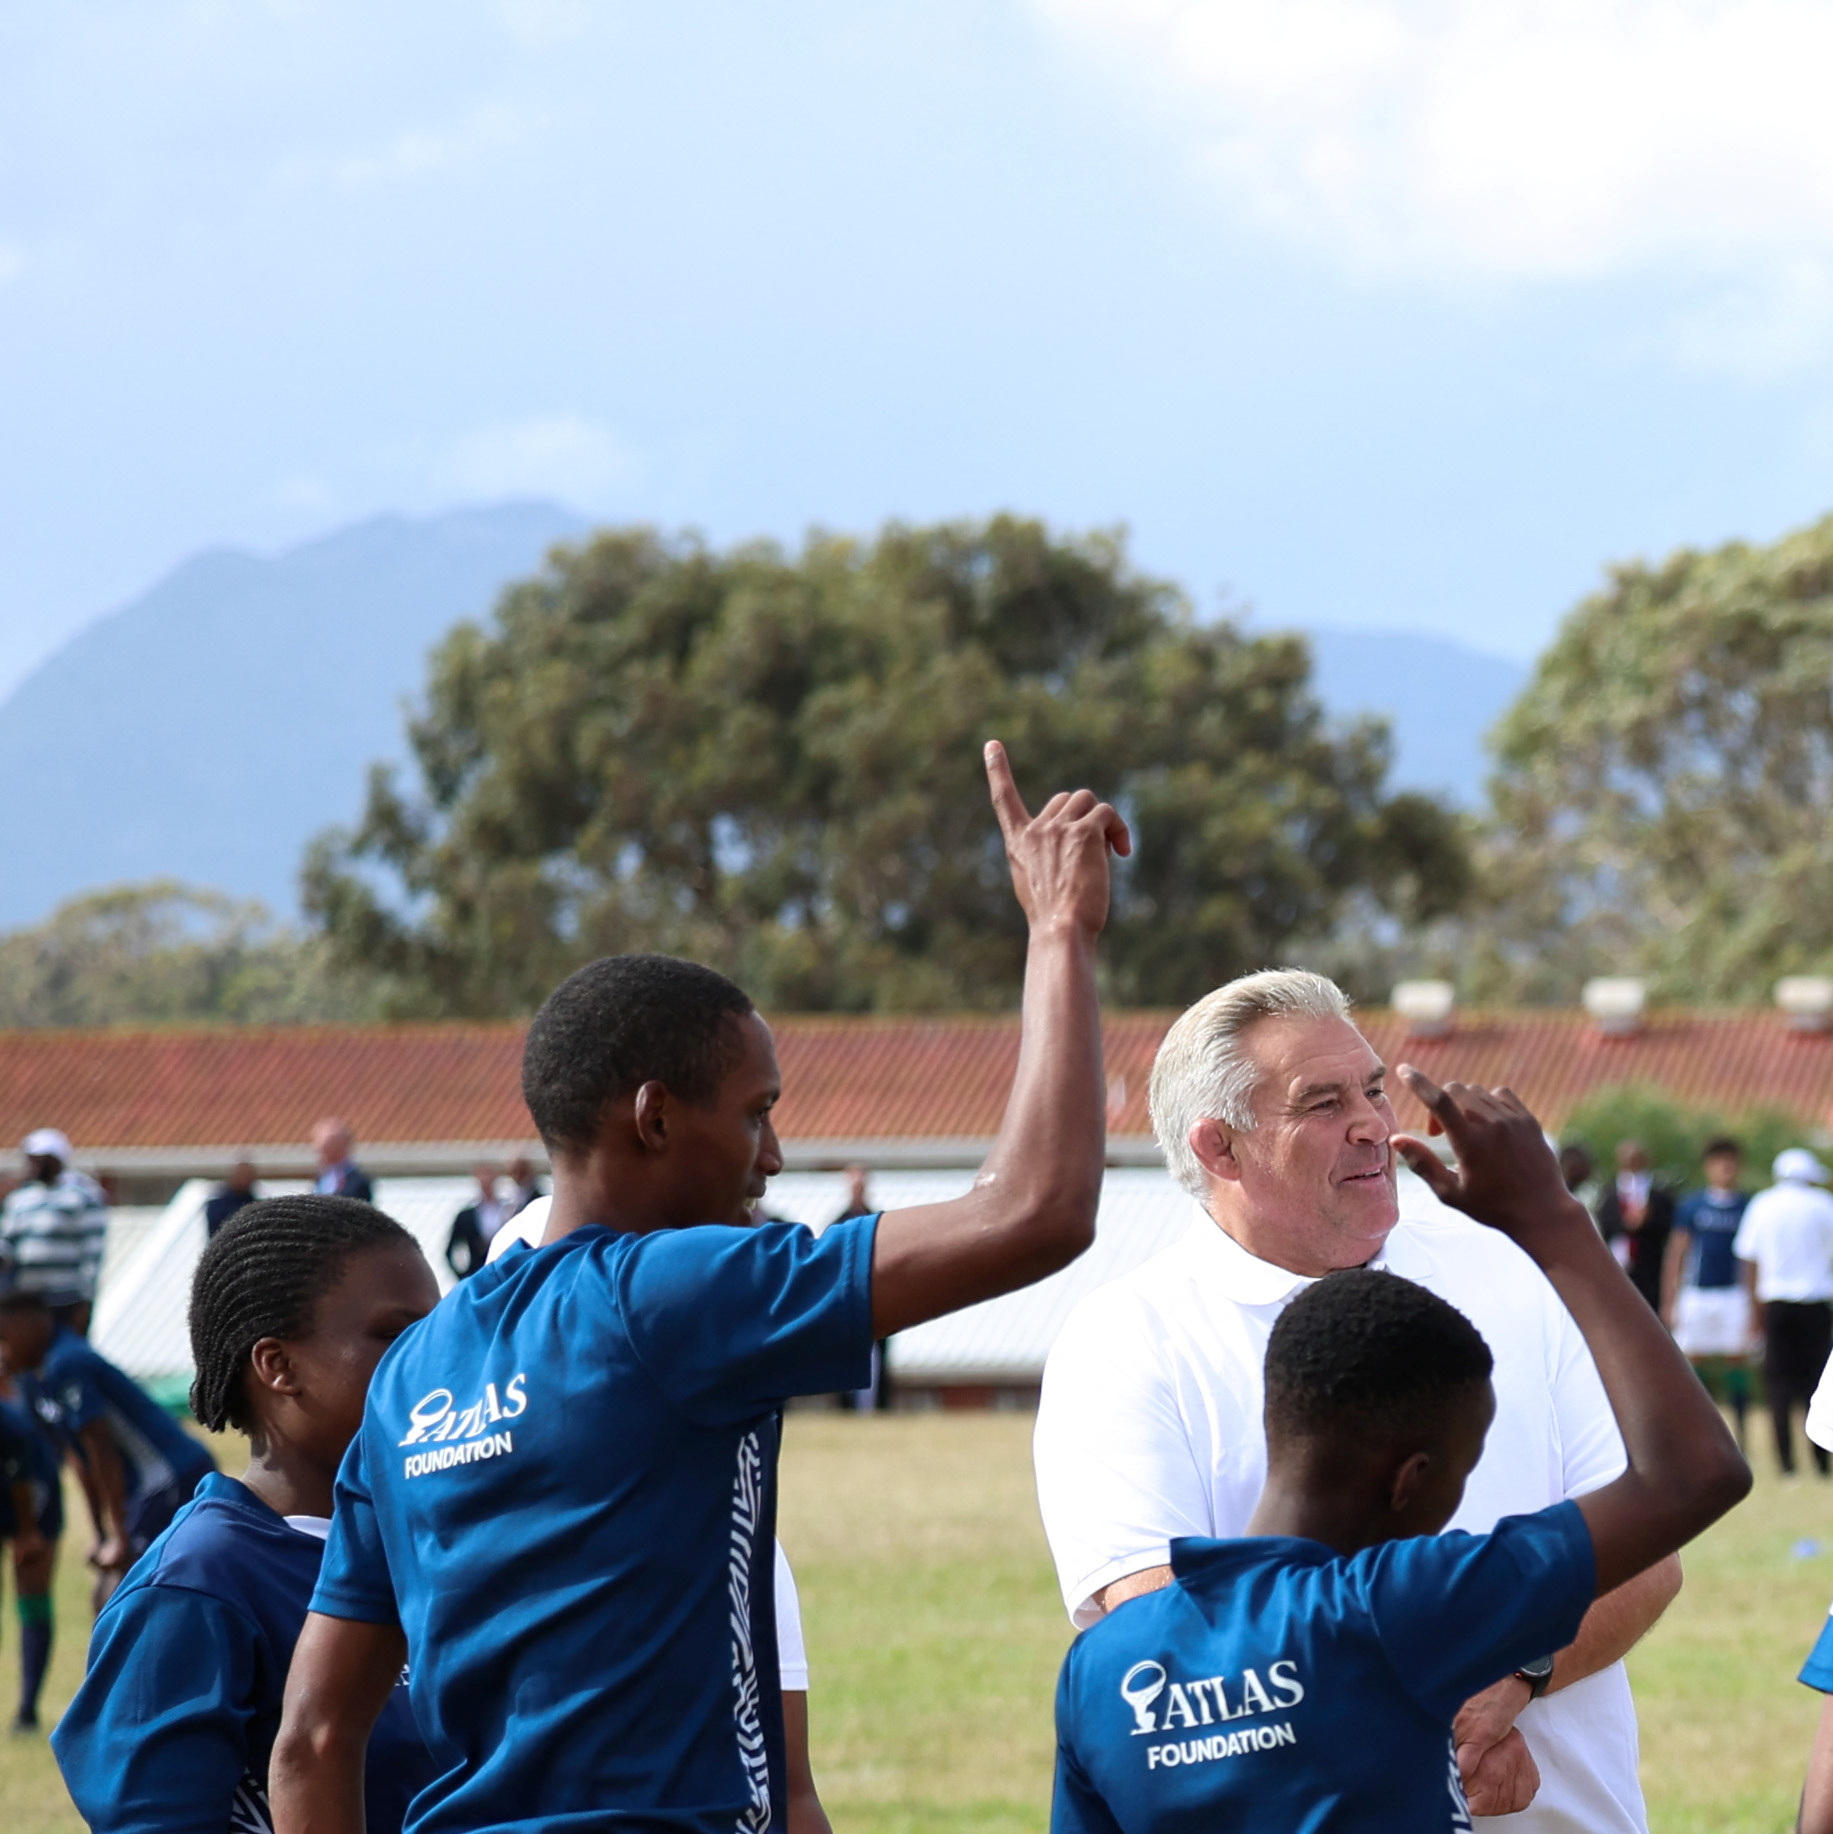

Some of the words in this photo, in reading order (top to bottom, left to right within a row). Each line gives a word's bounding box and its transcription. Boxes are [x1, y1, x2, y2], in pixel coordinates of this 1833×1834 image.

[418, 1373, 527, 1442] ATLAS
[404, 1431, 513, 1480] FOUNDATION
[1161, 1660, 1304, 1730] ATLAS
[1147, 1722, 1297, 1769] FOUNDATION
